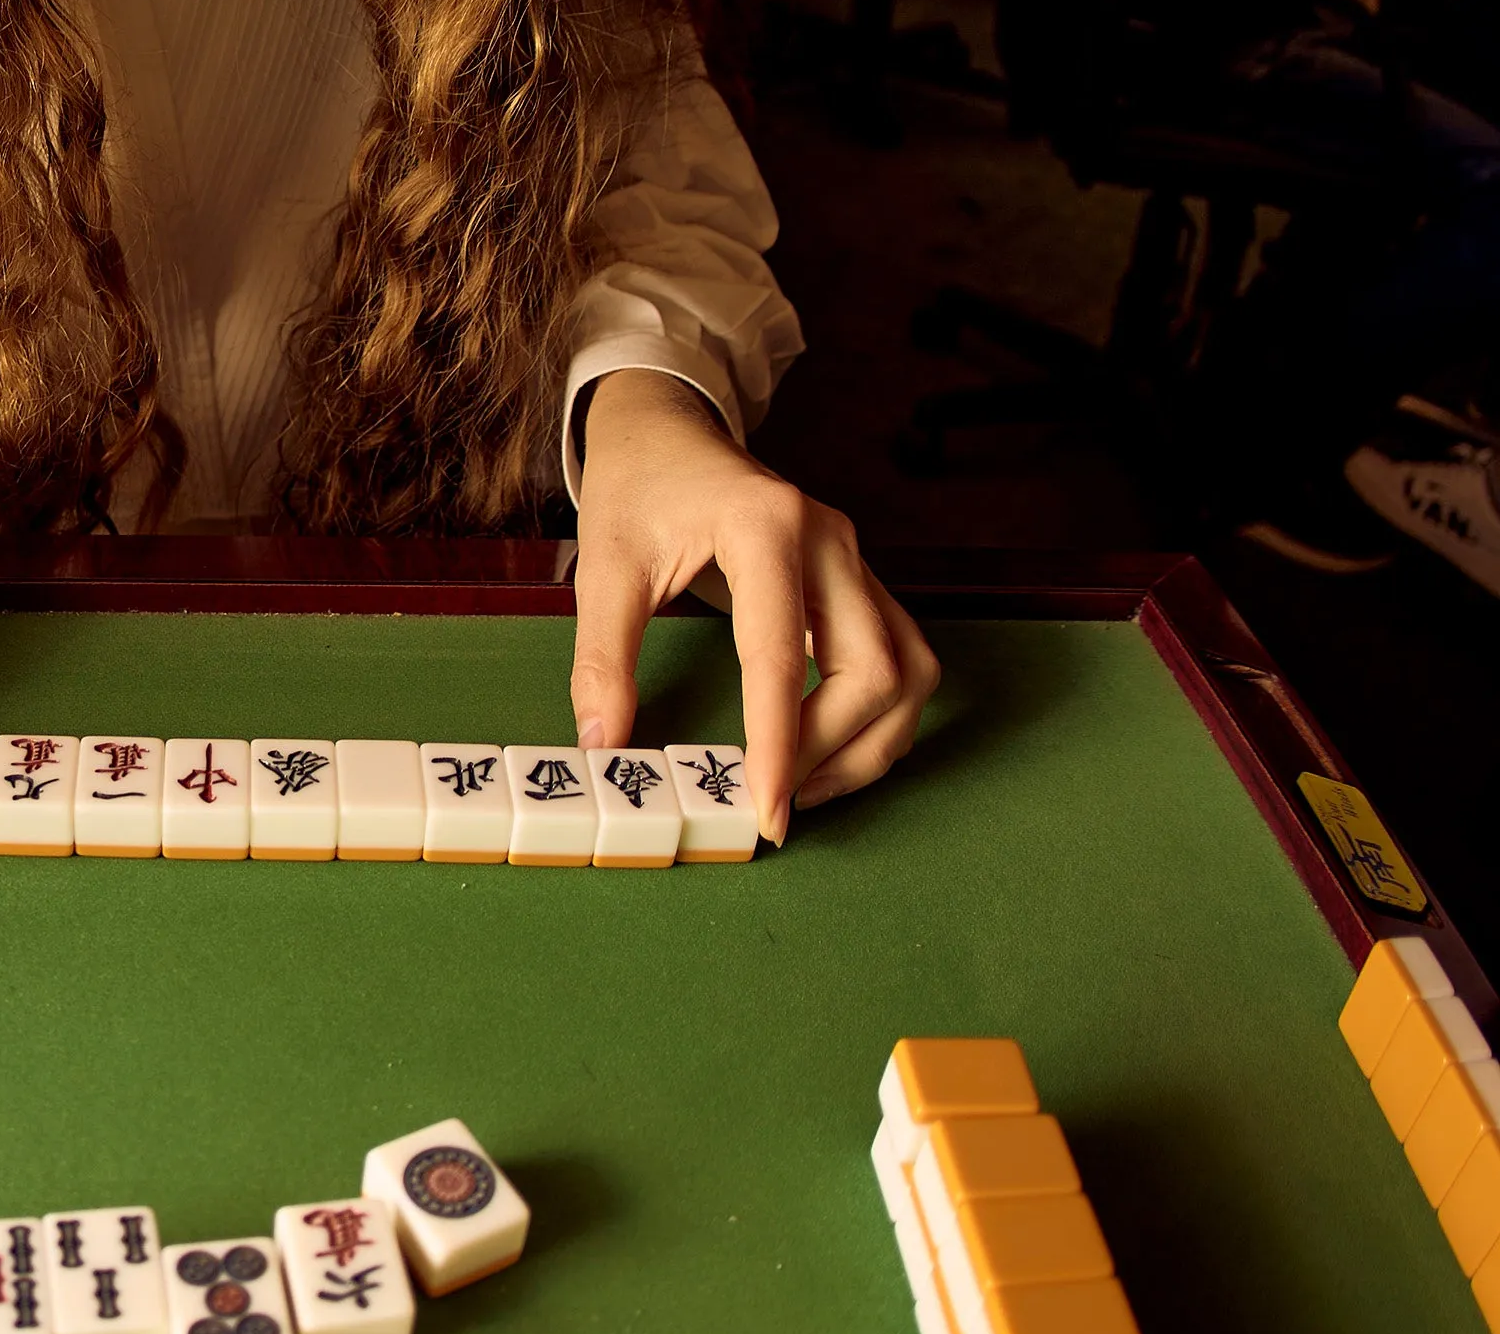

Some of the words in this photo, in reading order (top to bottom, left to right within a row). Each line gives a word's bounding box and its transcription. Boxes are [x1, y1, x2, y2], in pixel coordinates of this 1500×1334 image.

[177, 742, 237, 804] 中
[431, 757, 498, 797] 北
[524, 759, 586, 801] 西
[603, 755, 664, 809] 南
[677, 749, 742, 806] 東
